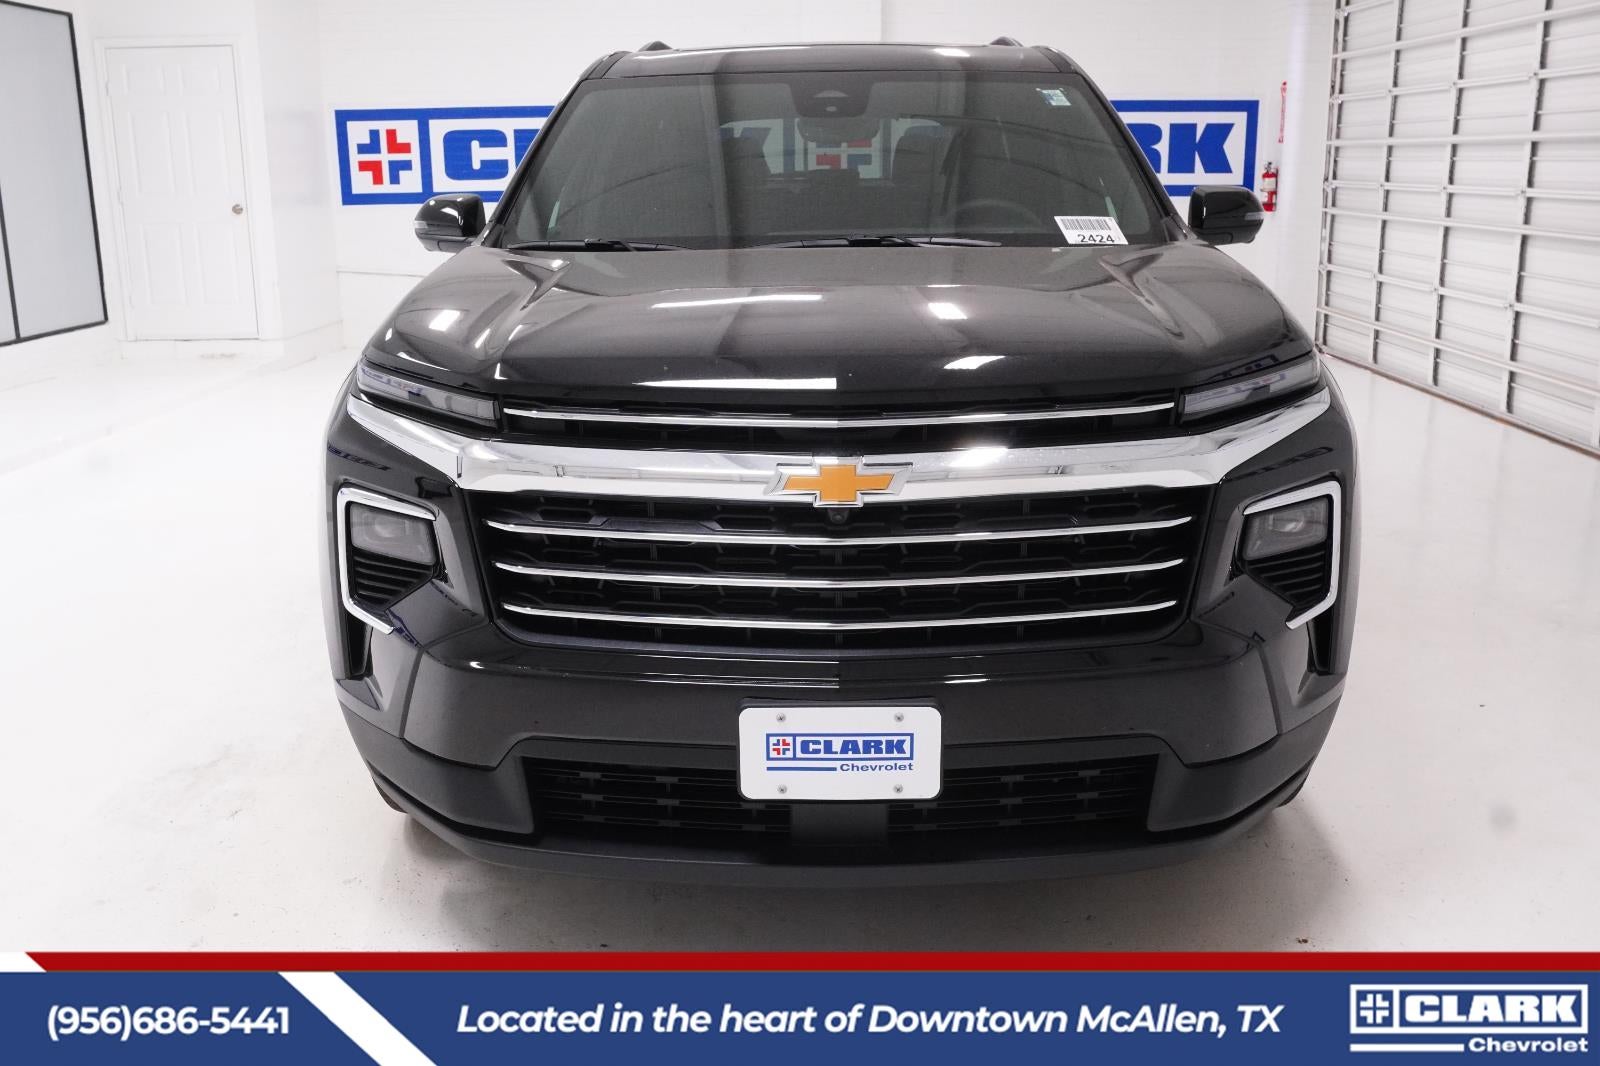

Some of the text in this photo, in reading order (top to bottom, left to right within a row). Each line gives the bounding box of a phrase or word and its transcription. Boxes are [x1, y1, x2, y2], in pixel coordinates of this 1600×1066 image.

[1077, 233, 1115, 243] 2424
[800, 739, 907, 755] CLARK
[839, 762, 914, 772] Chevrolet
